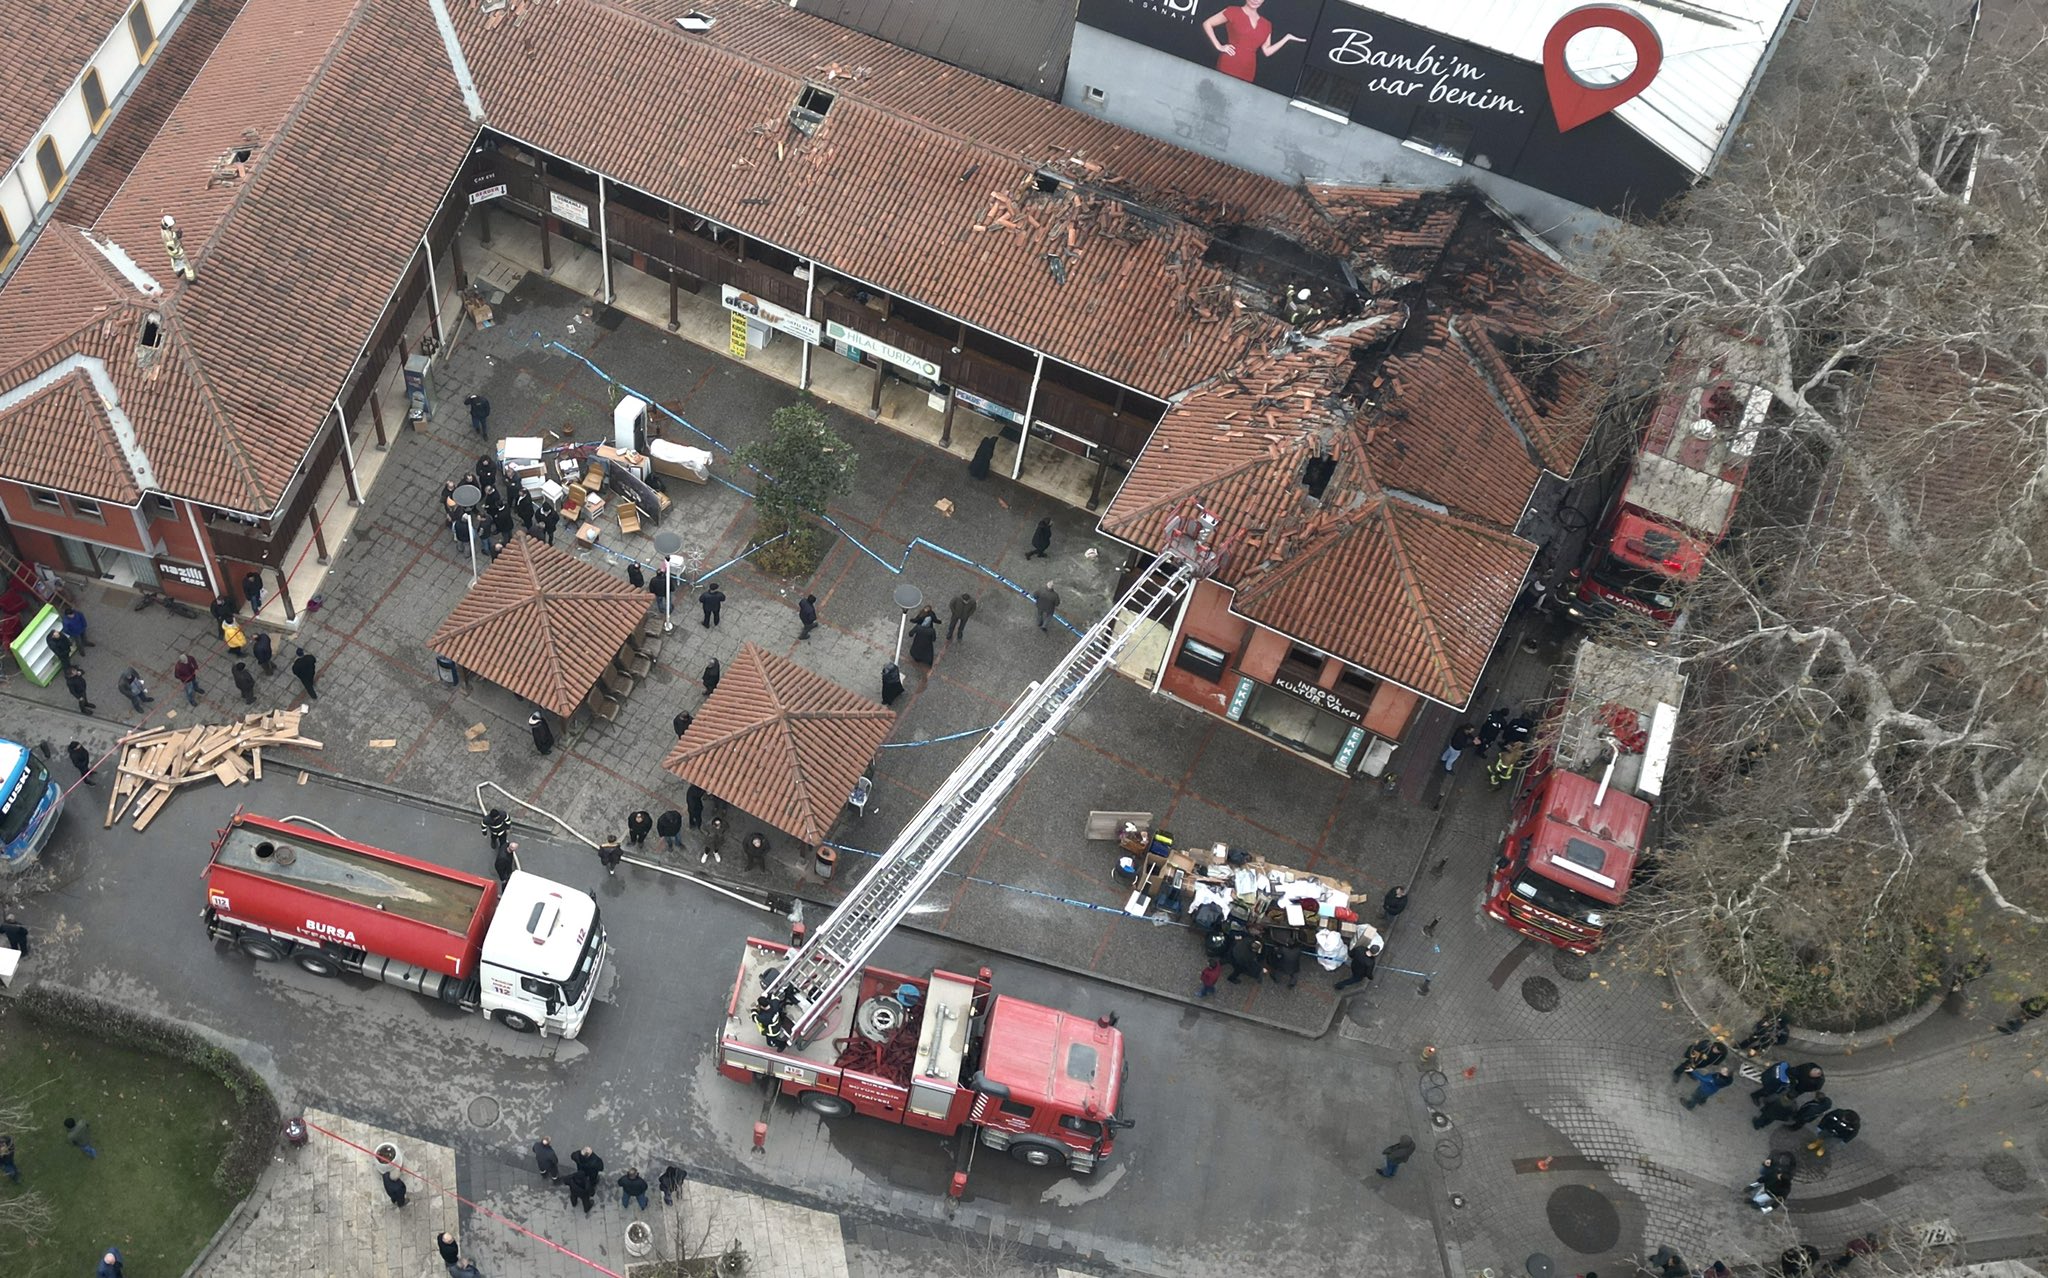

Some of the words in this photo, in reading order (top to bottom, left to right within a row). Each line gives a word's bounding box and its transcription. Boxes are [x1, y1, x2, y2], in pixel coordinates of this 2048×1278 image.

[1142, 1, 1194, 24] SANATI
[1328, 28, 1486, 80] Bambi'm
[1368, 77, 1424, 97] var
[1428, 74, 1525, 114] benim.
[760, 309, 784, 324] tur
[847, 331, 878, 351] HİLAL
[881, 345, 921, 369] TURİZM
[1326, 701, 1361, 721] VAKFI
[214, 897, 227, 906] 112
[306, 919, 356, 942] BURSA
[577, 928, 586, 945] 112
[495, 987, 511, 996] 112
